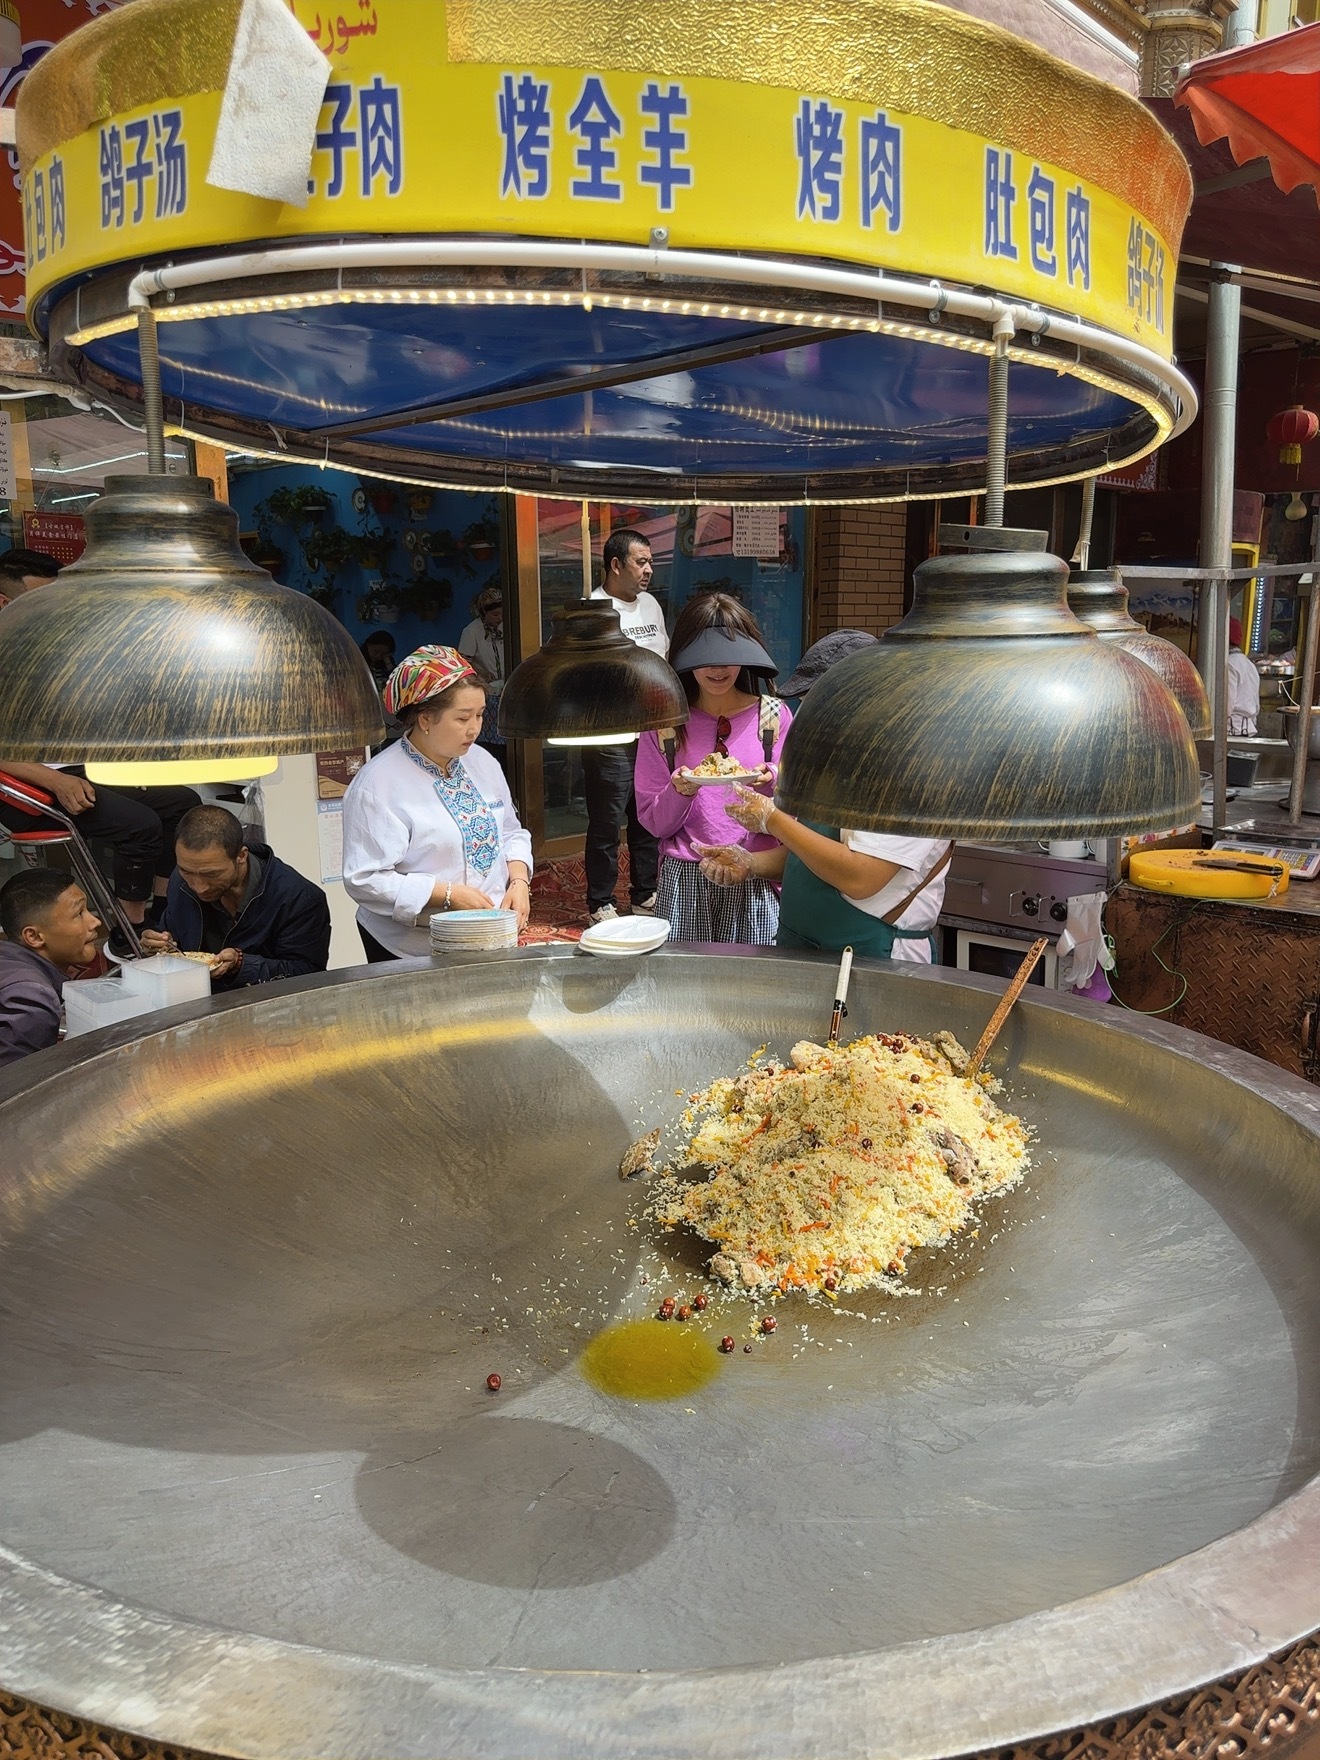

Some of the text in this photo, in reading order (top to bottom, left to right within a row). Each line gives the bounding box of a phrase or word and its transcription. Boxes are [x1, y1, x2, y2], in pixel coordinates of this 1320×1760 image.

[289, 0, 378, 56] شور
[100, 110, 187, 228] 鸽子汤
[307, 77, 402, 197] 子肉
[499, 75, 691, 209] 烤全羊
[796, 100, 901, 231] 烤肉
[984, 148, 1090, 290] 肚包肉
[1127, 215, 1164, 334] 鸽子汤
